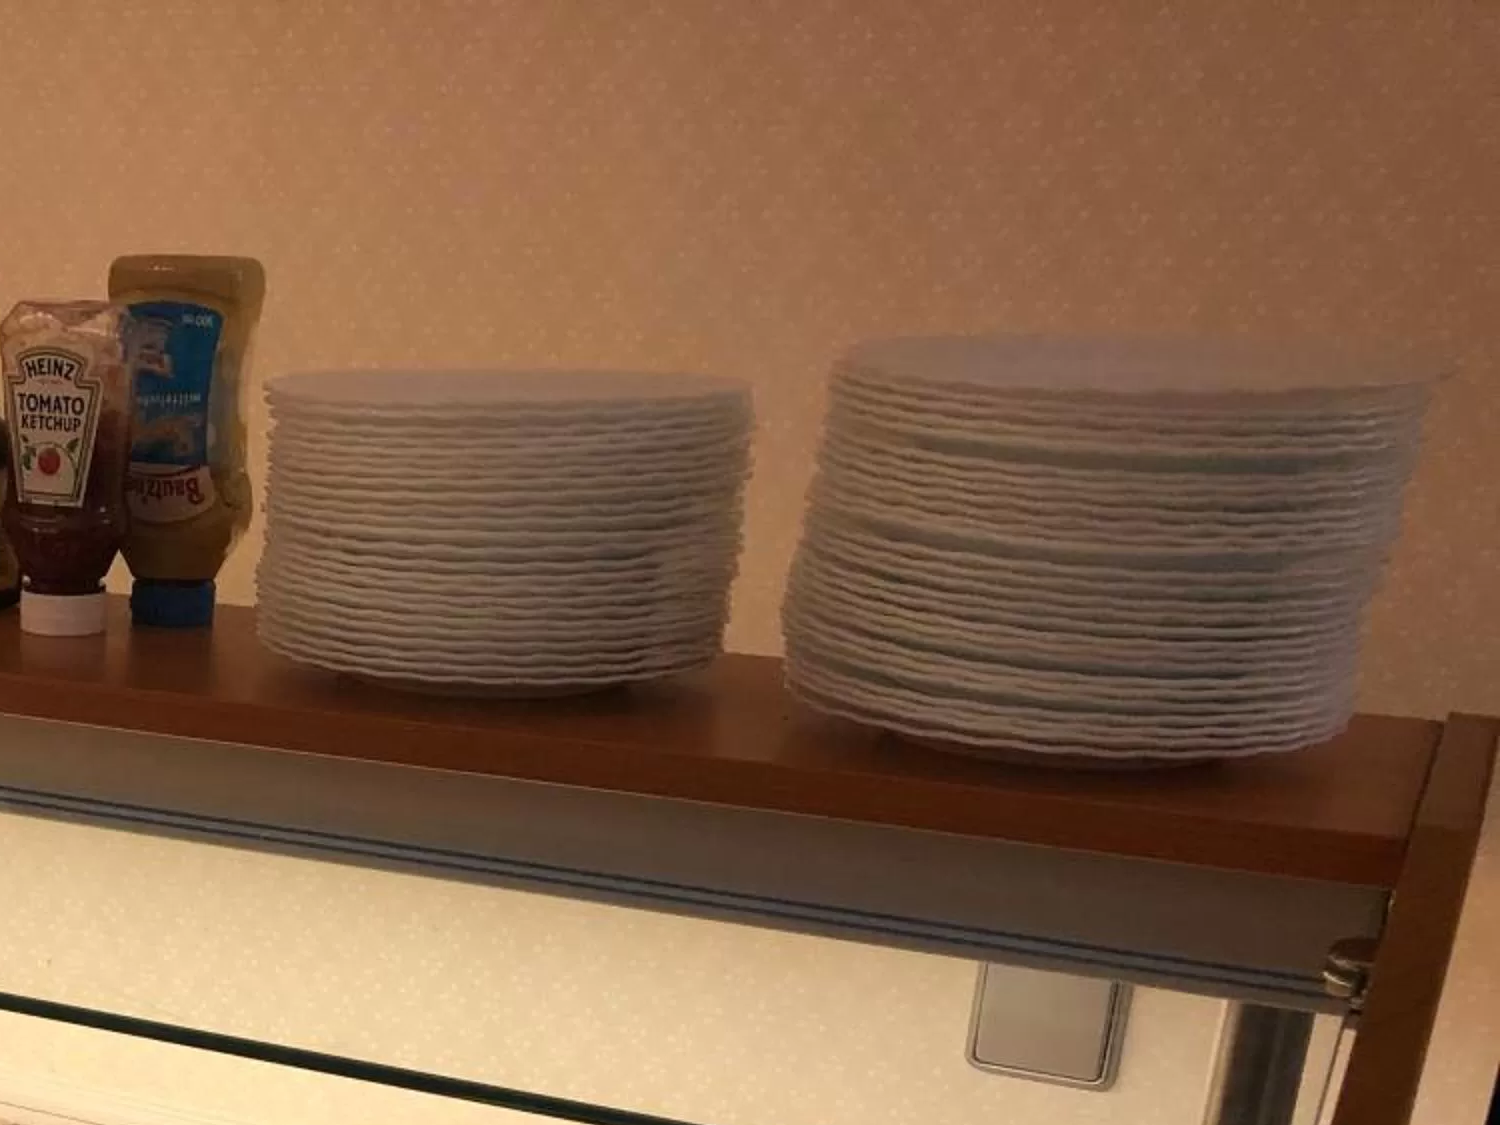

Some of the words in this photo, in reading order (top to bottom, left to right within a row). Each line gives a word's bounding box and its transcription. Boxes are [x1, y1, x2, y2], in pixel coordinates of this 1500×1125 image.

[25, 358, 75, 381] HEINZ
[17, 391, 85, 416] TOMATO
[21, 414, 81, 432] KETCHUP
